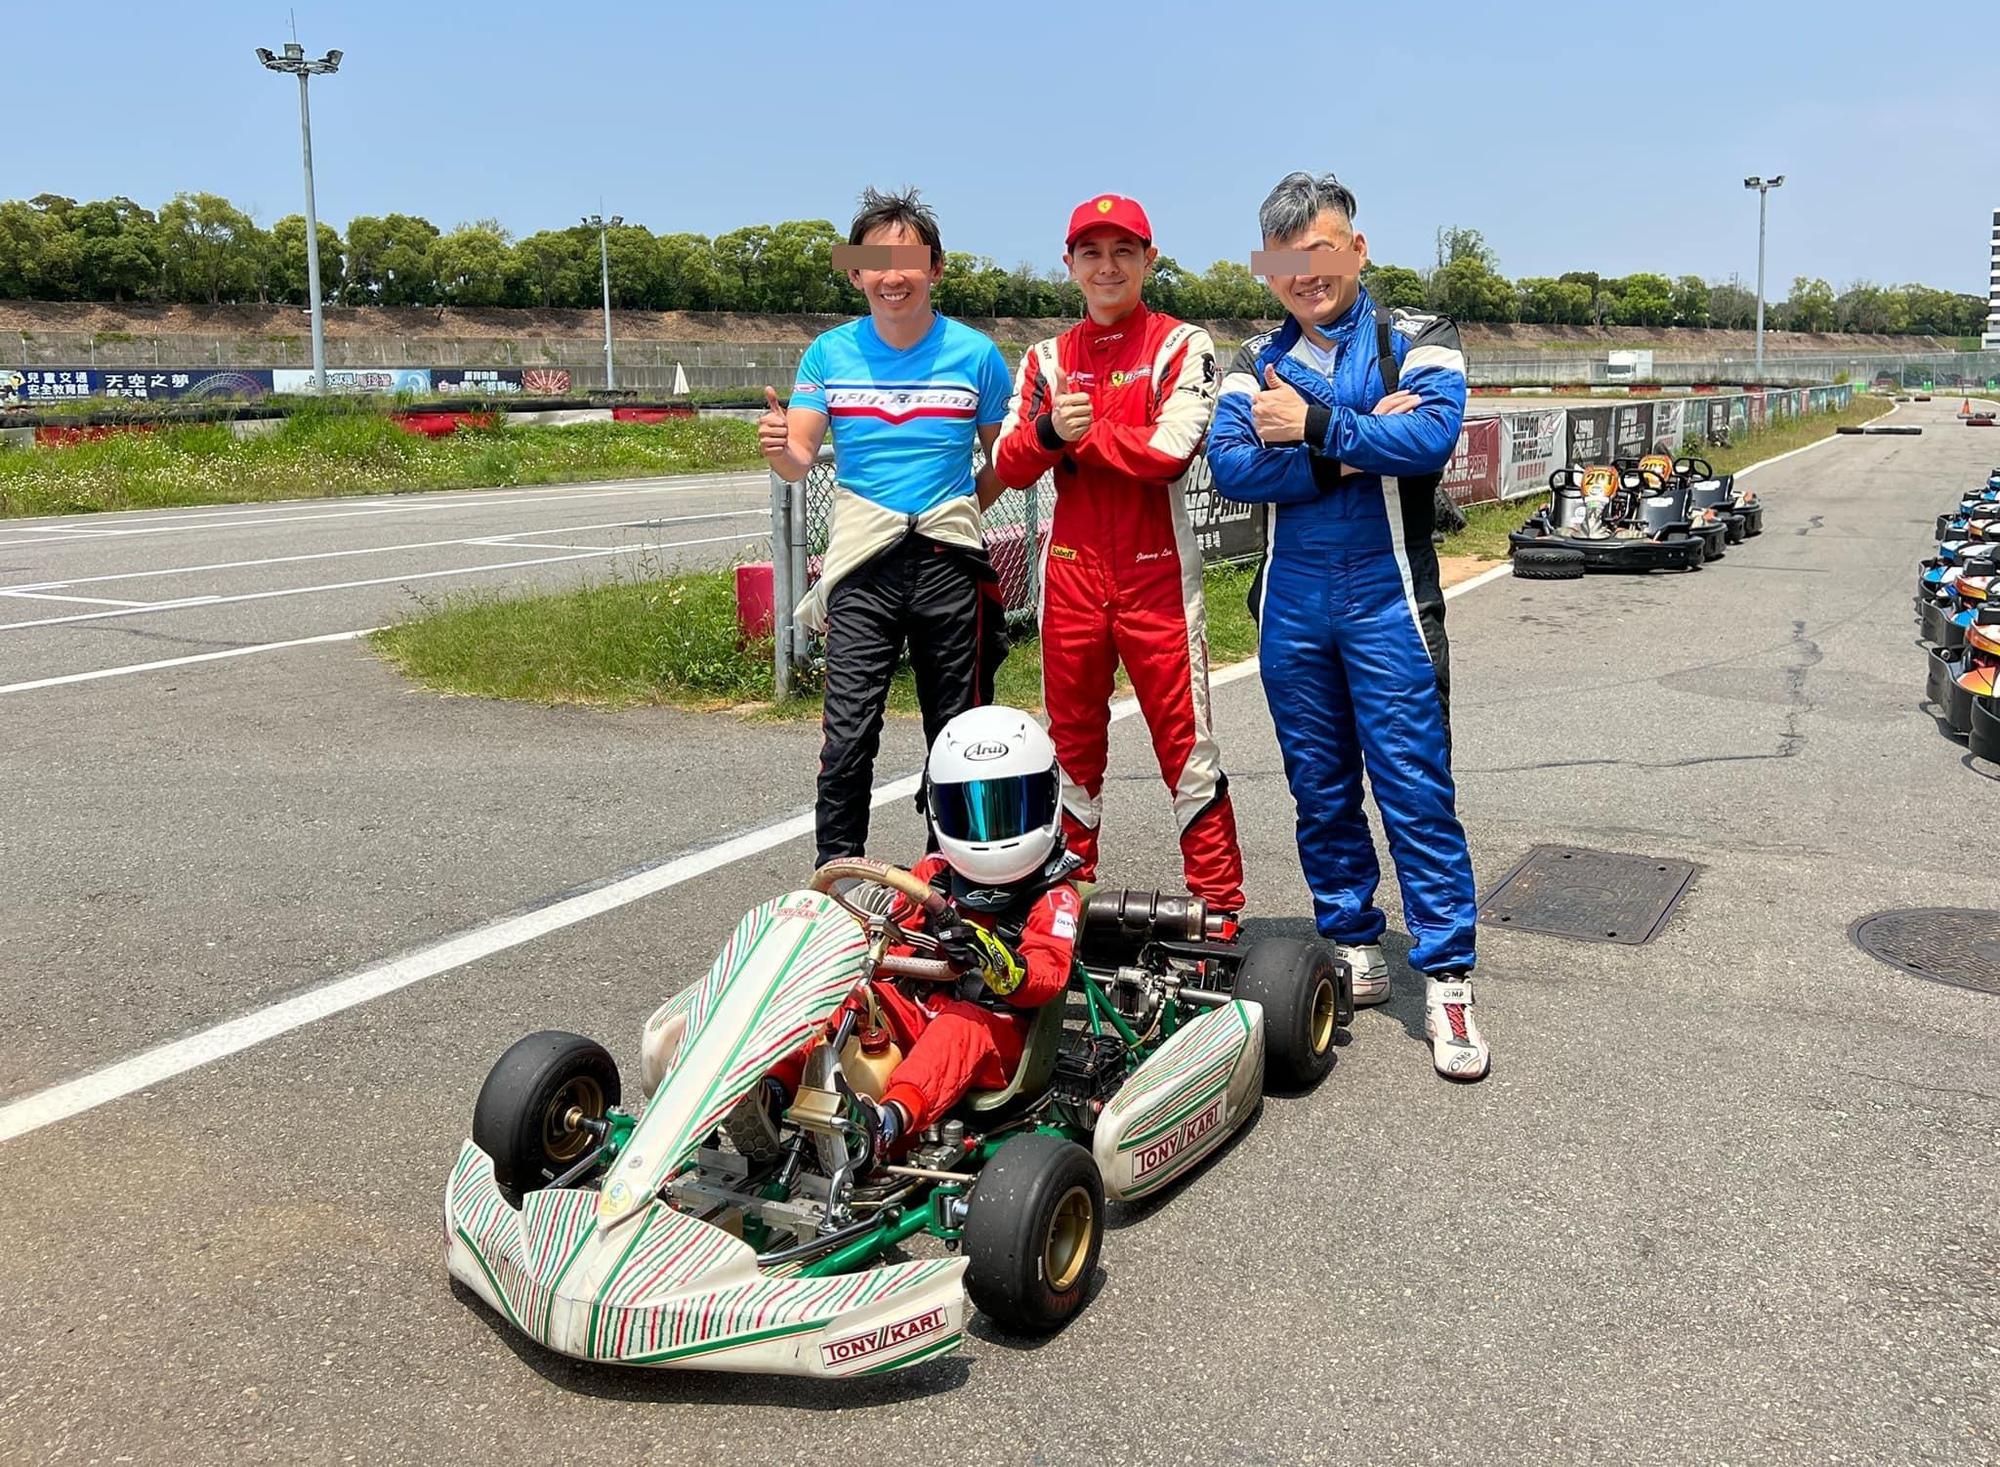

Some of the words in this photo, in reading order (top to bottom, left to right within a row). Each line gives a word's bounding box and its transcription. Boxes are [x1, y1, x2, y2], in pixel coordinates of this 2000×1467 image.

[105, 373, 189, 388] 天空之夢
[967, 743, 1002, 756] Arai
[1443, 990, 1464, 998] OMP
[1135, 1131, 1179, 1172] TONY
[1186, 1100, 1221, 1143] KART
[822, 1331, 878, 1361] TONY
[890, 1306, 943, 1342] KART
